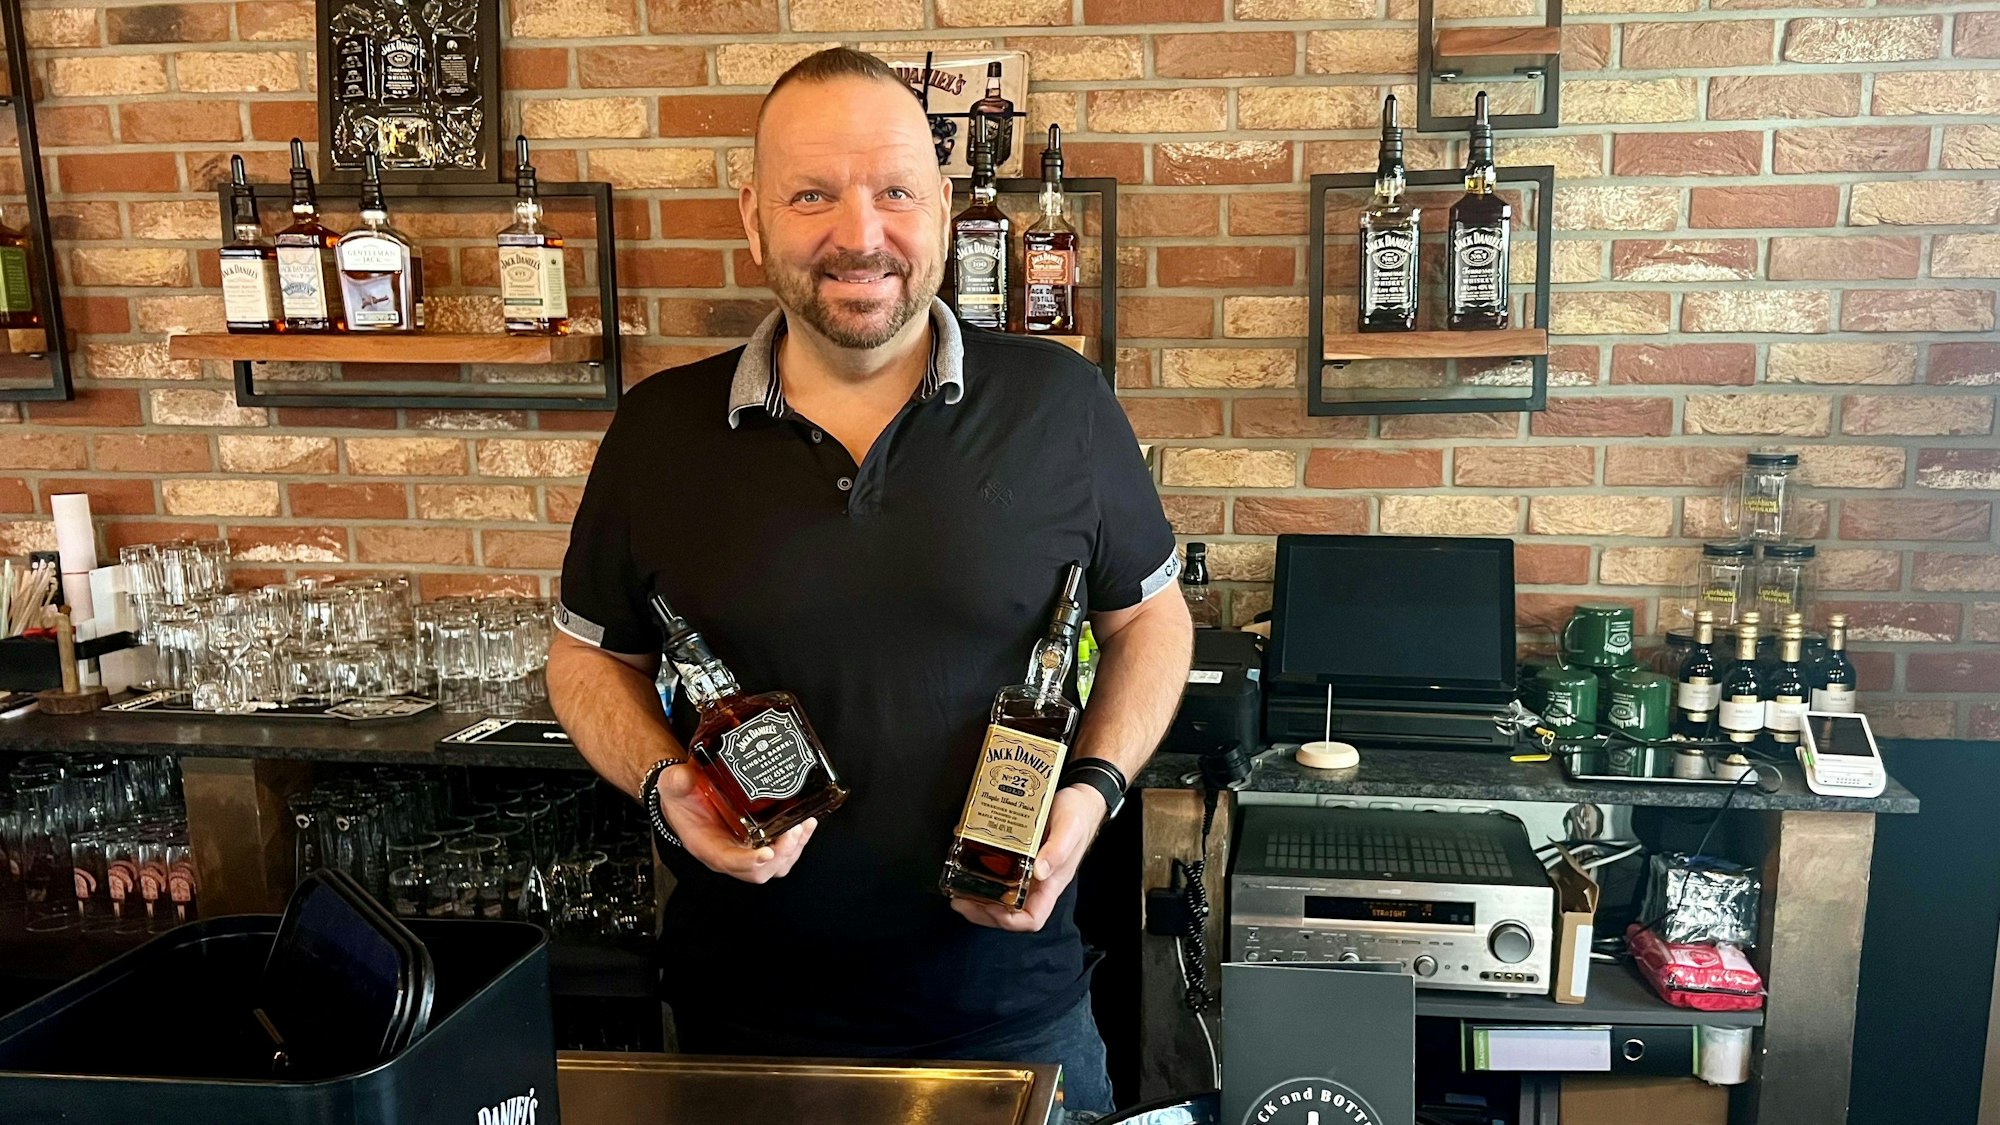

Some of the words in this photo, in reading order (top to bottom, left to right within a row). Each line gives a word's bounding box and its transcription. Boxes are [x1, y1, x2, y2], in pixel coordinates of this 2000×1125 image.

[381, 42, 396, 56] JACK
[957, 244, 975, 260] JACK
[974, 241, 1001, 260] DANIEL'S
[1366, 238, 1386, 254] JACK
[1454, 235, 1474, 252] JACK
[501, 256, 517, 269] JACK
[516, 254, 540, 270] DANIEL'S
[222, 268, 236, 278] JACK
[1164, 555, 1179, 577] CA
[1702, 586, 1736, 598] Lynchburg
[1758, 586, 1790, 599] Lynchburg
[736, 734, 752, 753] JACK
[748, 723, 777, 740] DANIEL'S
[742, 752, 767, 771] SINGLE
[767, 740, 794, 757] BARREL
[760, 753, 783, 769] SELECT
[986, 747, 1013, 763] JACK
[1014, 745, 1054, 780] DANIEL'S
[773, 768, 786, 778] 45%
[998, 785, 1025, 797] GOLD
[981, 791, 1000, 802] Maple
[1000, 796, 1018, 807] Wood
[1017, 801, 1035, 811] Finish
[1280, 1087, 1313, 1106] and
[477, 1087, 539, 1125] DANIEL'S
